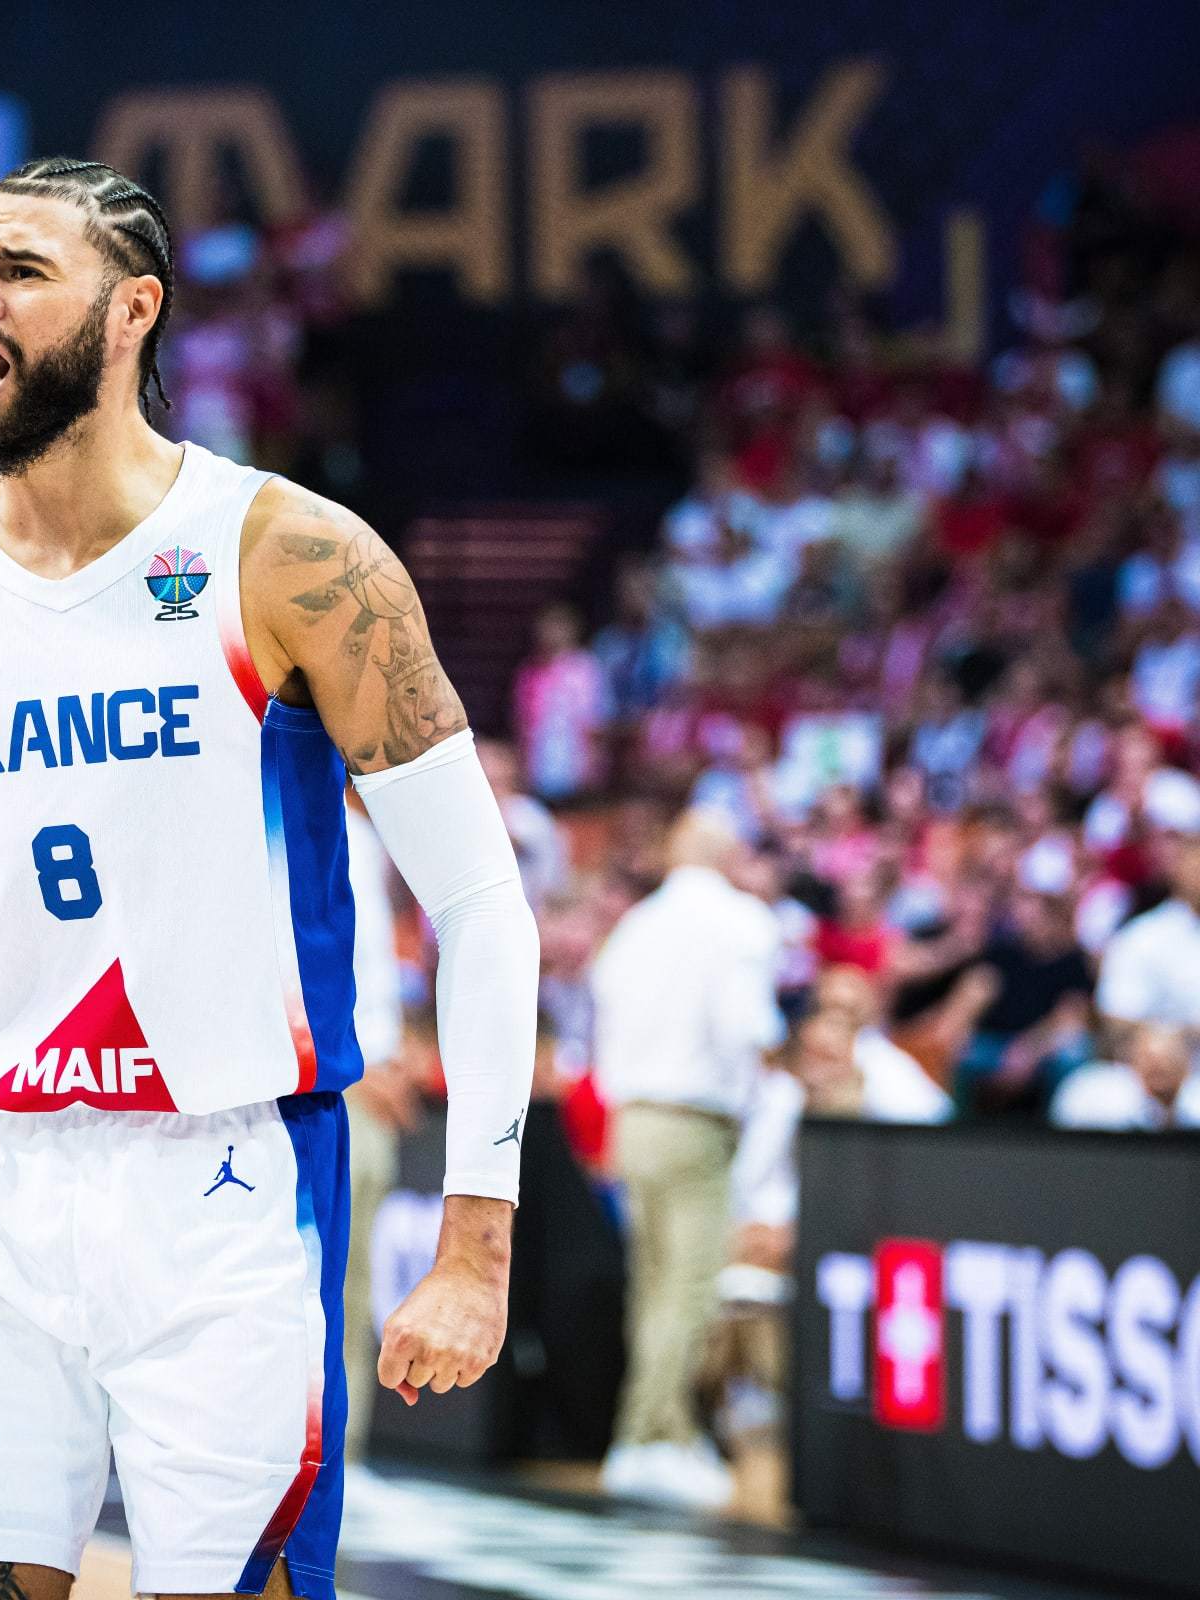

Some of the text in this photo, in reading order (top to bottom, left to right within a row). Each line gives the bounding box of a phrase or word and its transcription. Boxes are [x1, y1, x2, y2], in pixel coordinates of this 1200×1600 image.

[31, 823, 103, 921] 8
[10, 1047, 156, 1094] MAIF
[944, 1238, 1200, 1472] TISS
